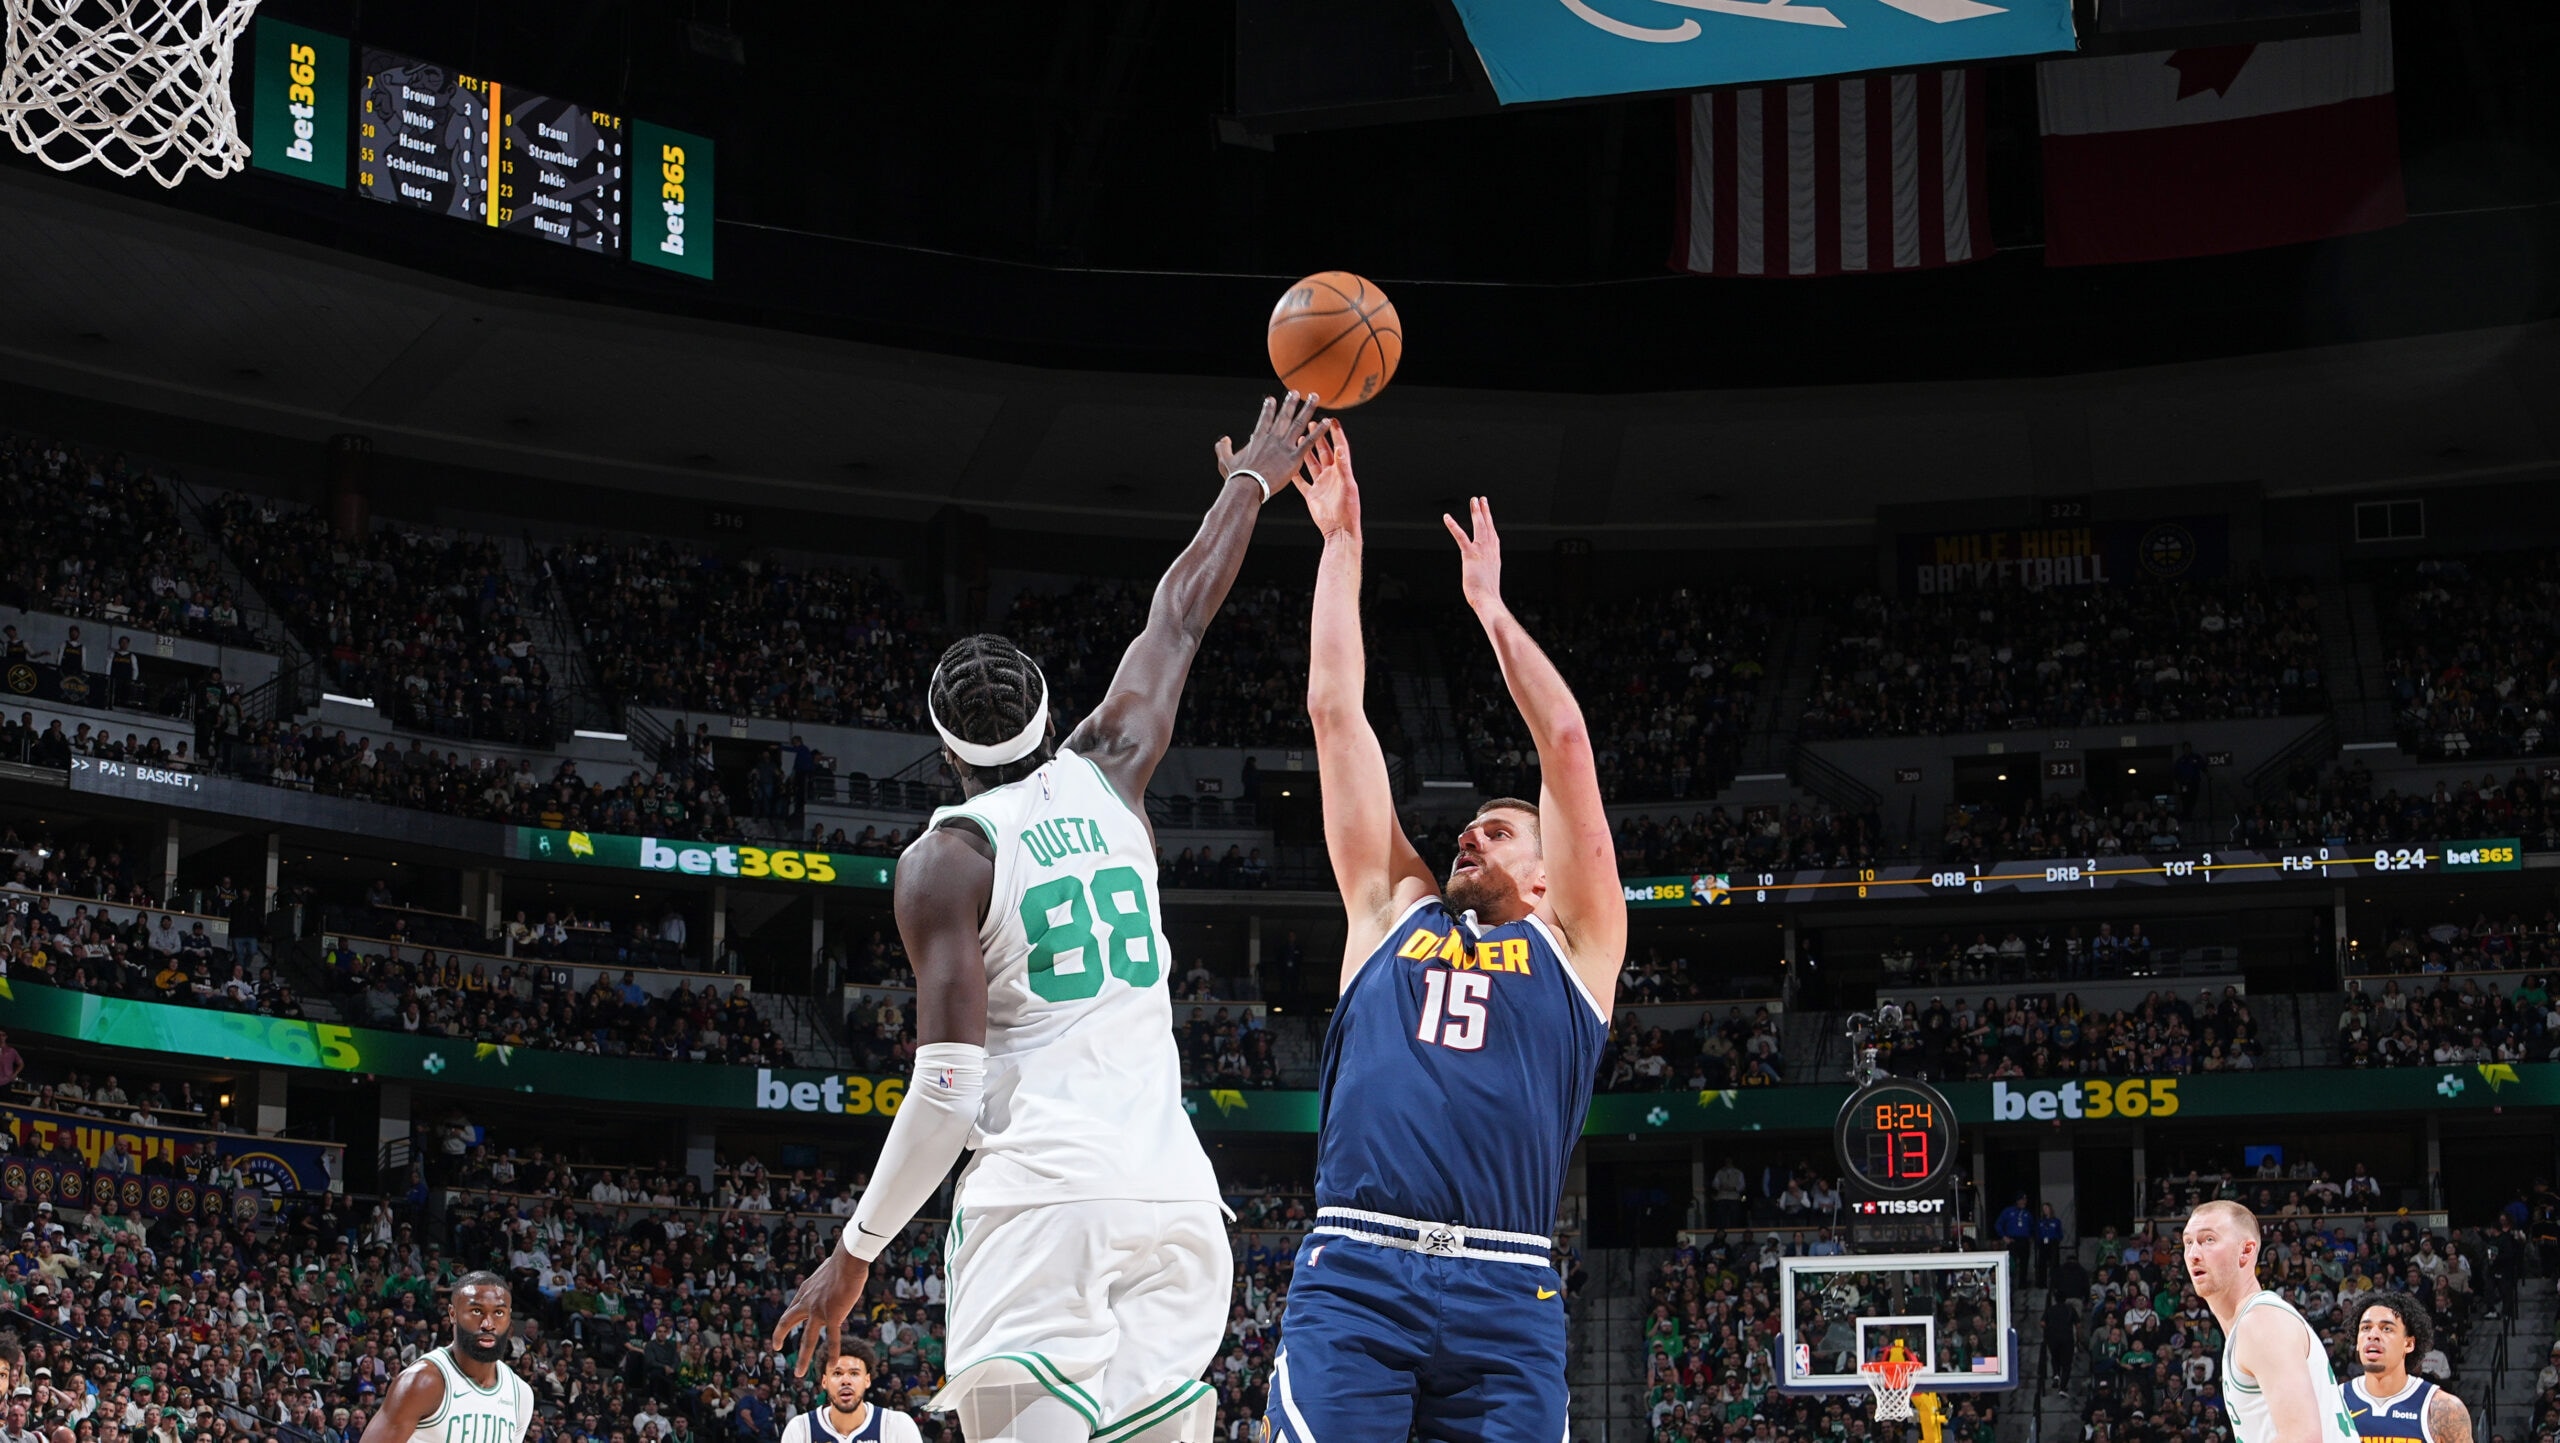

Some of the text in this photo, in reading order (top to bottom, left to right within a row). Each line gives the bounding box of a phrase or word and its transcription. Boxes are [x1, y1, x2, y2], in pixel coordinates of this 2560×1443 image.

[366, 76, 488, 121] 7 Brown 3 0
[458, 74, 488, 94] PTS F
[287, 43, 315, 162] bet365
[366, 100, 488, 144] 9 White 0 0
[505, 114, 621, 156] 0 Braun 0 0
[592, 111, 621, 130] PTS F
[362, 123, 488, 168] 30 Hauser 0 0
[505, 137, 621, 179] 3 Strawther 0 0
[361, 147, 487, 192] 55 Scheierman 3 0
[501, 160, 621, 202] 15 Jokic 3 0
[360, 171, 487, 215] 88 Queta 4 0
[500, 184, 620, 225] 23 Johnson 3 0
[661, 144, 685, 256] bet365
[500, 208, 619, 248] 27 Murray 2 1
[711, 512, 744, 529] 316
[1935, 527, 2092, 565] MILE HIGH
[99, 761, 126, 777] PA:
[136, 767, 199, 792] BASKET,
[2050, 763, 2074, 776] 321
[1020, 818, 1109, 868] QUETA
[2446, 848, 2514, 865] bet365
[640, 837, 837, 883] bet365
[2046, 859, 2096, 883] DRB 2
[2163, 853, 2212, 878] TOT 3
[2282, 848, 2329, 872] FLS 0
[2321, 865, 2328, 878] 1
[2374, 848, 2427, 871] 8:24
[1757, 869, 1875, 887] 10 10
[1931, 864, 1980, 888] ORB 1
[1973, 881, 1982, 894] 0
[2088, 875, 2095, 888] 1
[2204, 870, 2211, 883] 1
[1624, 884, 1685, 901] bet365
[1757, 885, 1867, 902] 8 8
[1019, 865, 1160, 1003] 88
[1417, 968, 1493, 1050] 15
[756, 1068, 906, 1117] bet36
[1992, 1078, 2180, 1121] bet365
[1876, 1103, 1933, 1130] 8:24
[1887, 1131, 1929, 1179] 13
[1876, 1199, 1945, 1215] TISSOT
[2391, 1409, 2418, 1421] ibotta
